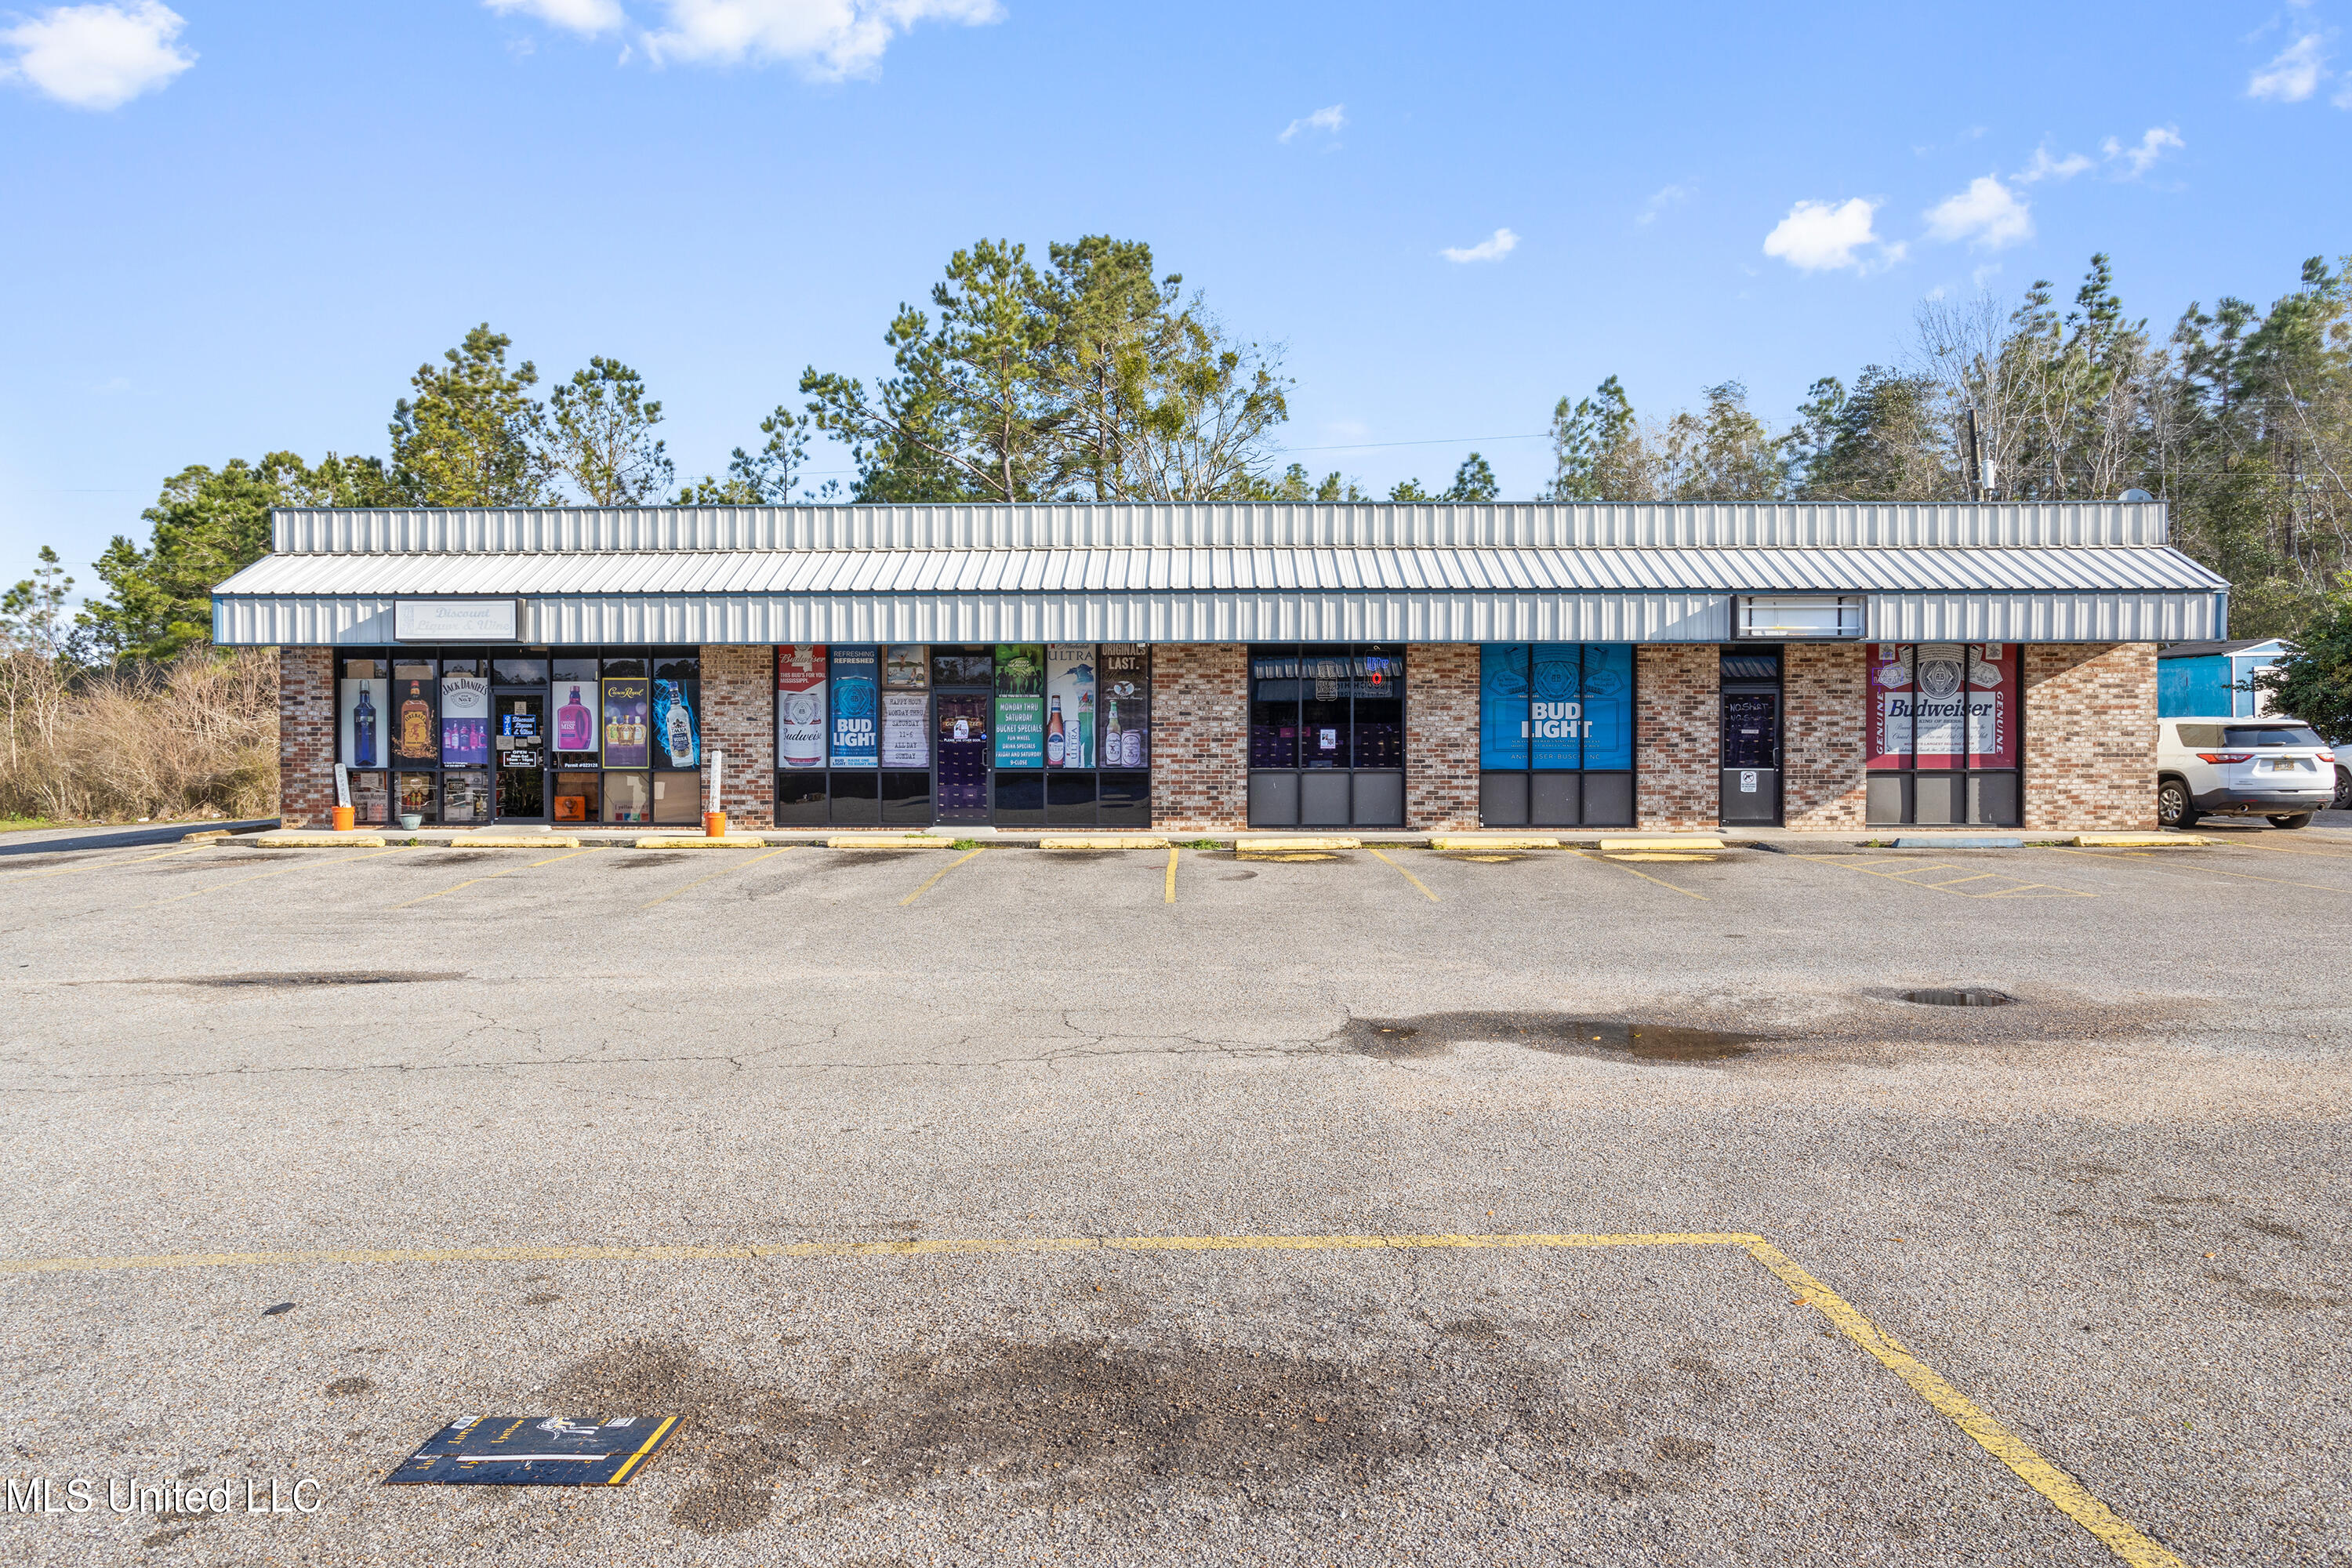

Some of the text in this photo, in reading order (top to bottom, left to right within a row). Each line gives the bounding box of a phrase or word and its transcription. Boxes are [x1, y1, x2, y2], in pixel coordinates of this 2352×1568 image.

[435, 607, 490, 618] Discount
[779, 653, 826, 664] Budweiser
[1048, 651, 1094, 661] ULTRA
[1109, 657, 1140, 670] LAST.
[443, 681, 460, 695] JACK
[608, 687, 644, 698] Crown Royal
[1000, 702, 1038, 711] MONDAY THRU
[1532, 702, 1581, 720] BUD
[1888, 699, 1993, 717] Budweiser
[837, 719, 873, 732] BUD
[996, 724, 1043, 732] BUCKET SPECIALS
[1521, 720, 1593, 738] LIGHT
[833, 732, 877, 746] LIGHT
